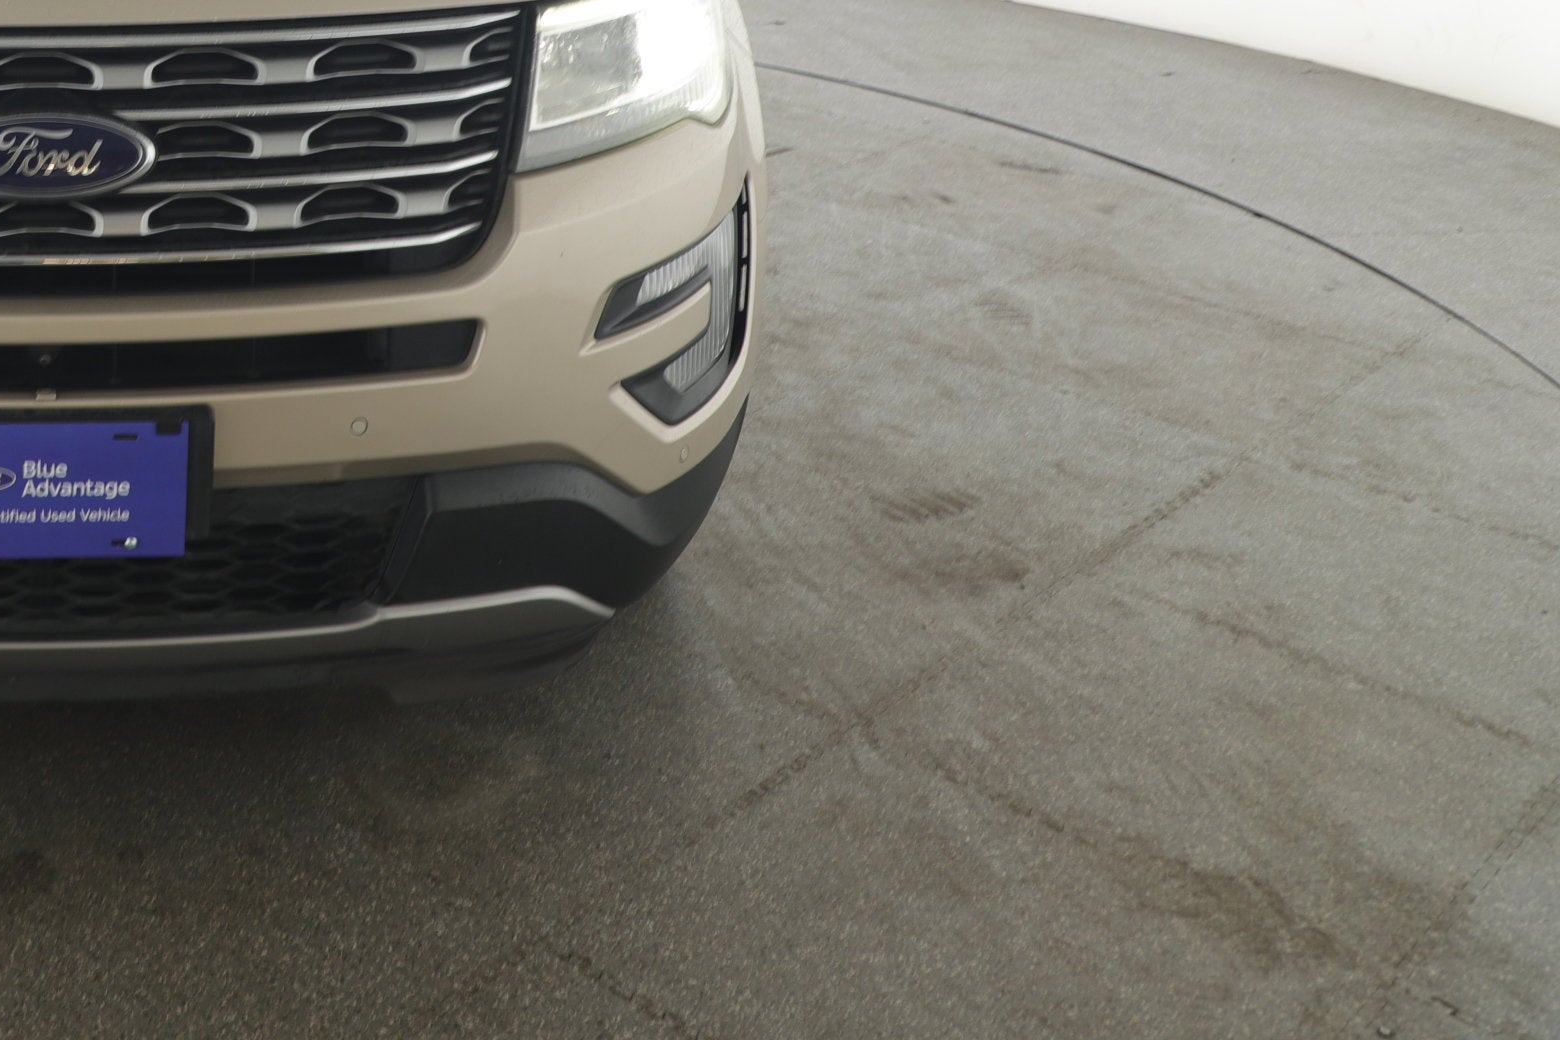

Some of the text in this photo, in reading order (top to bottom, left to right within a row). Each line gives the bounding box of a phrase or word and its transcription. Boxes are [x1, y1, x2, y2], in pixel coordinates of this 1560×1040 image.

[23, 459, 67, 478] Blue
[21, 478, 130, 500] Advantage
[41, 508, 76, 523] Used
[80, 508, 130, 523] Vehicle
